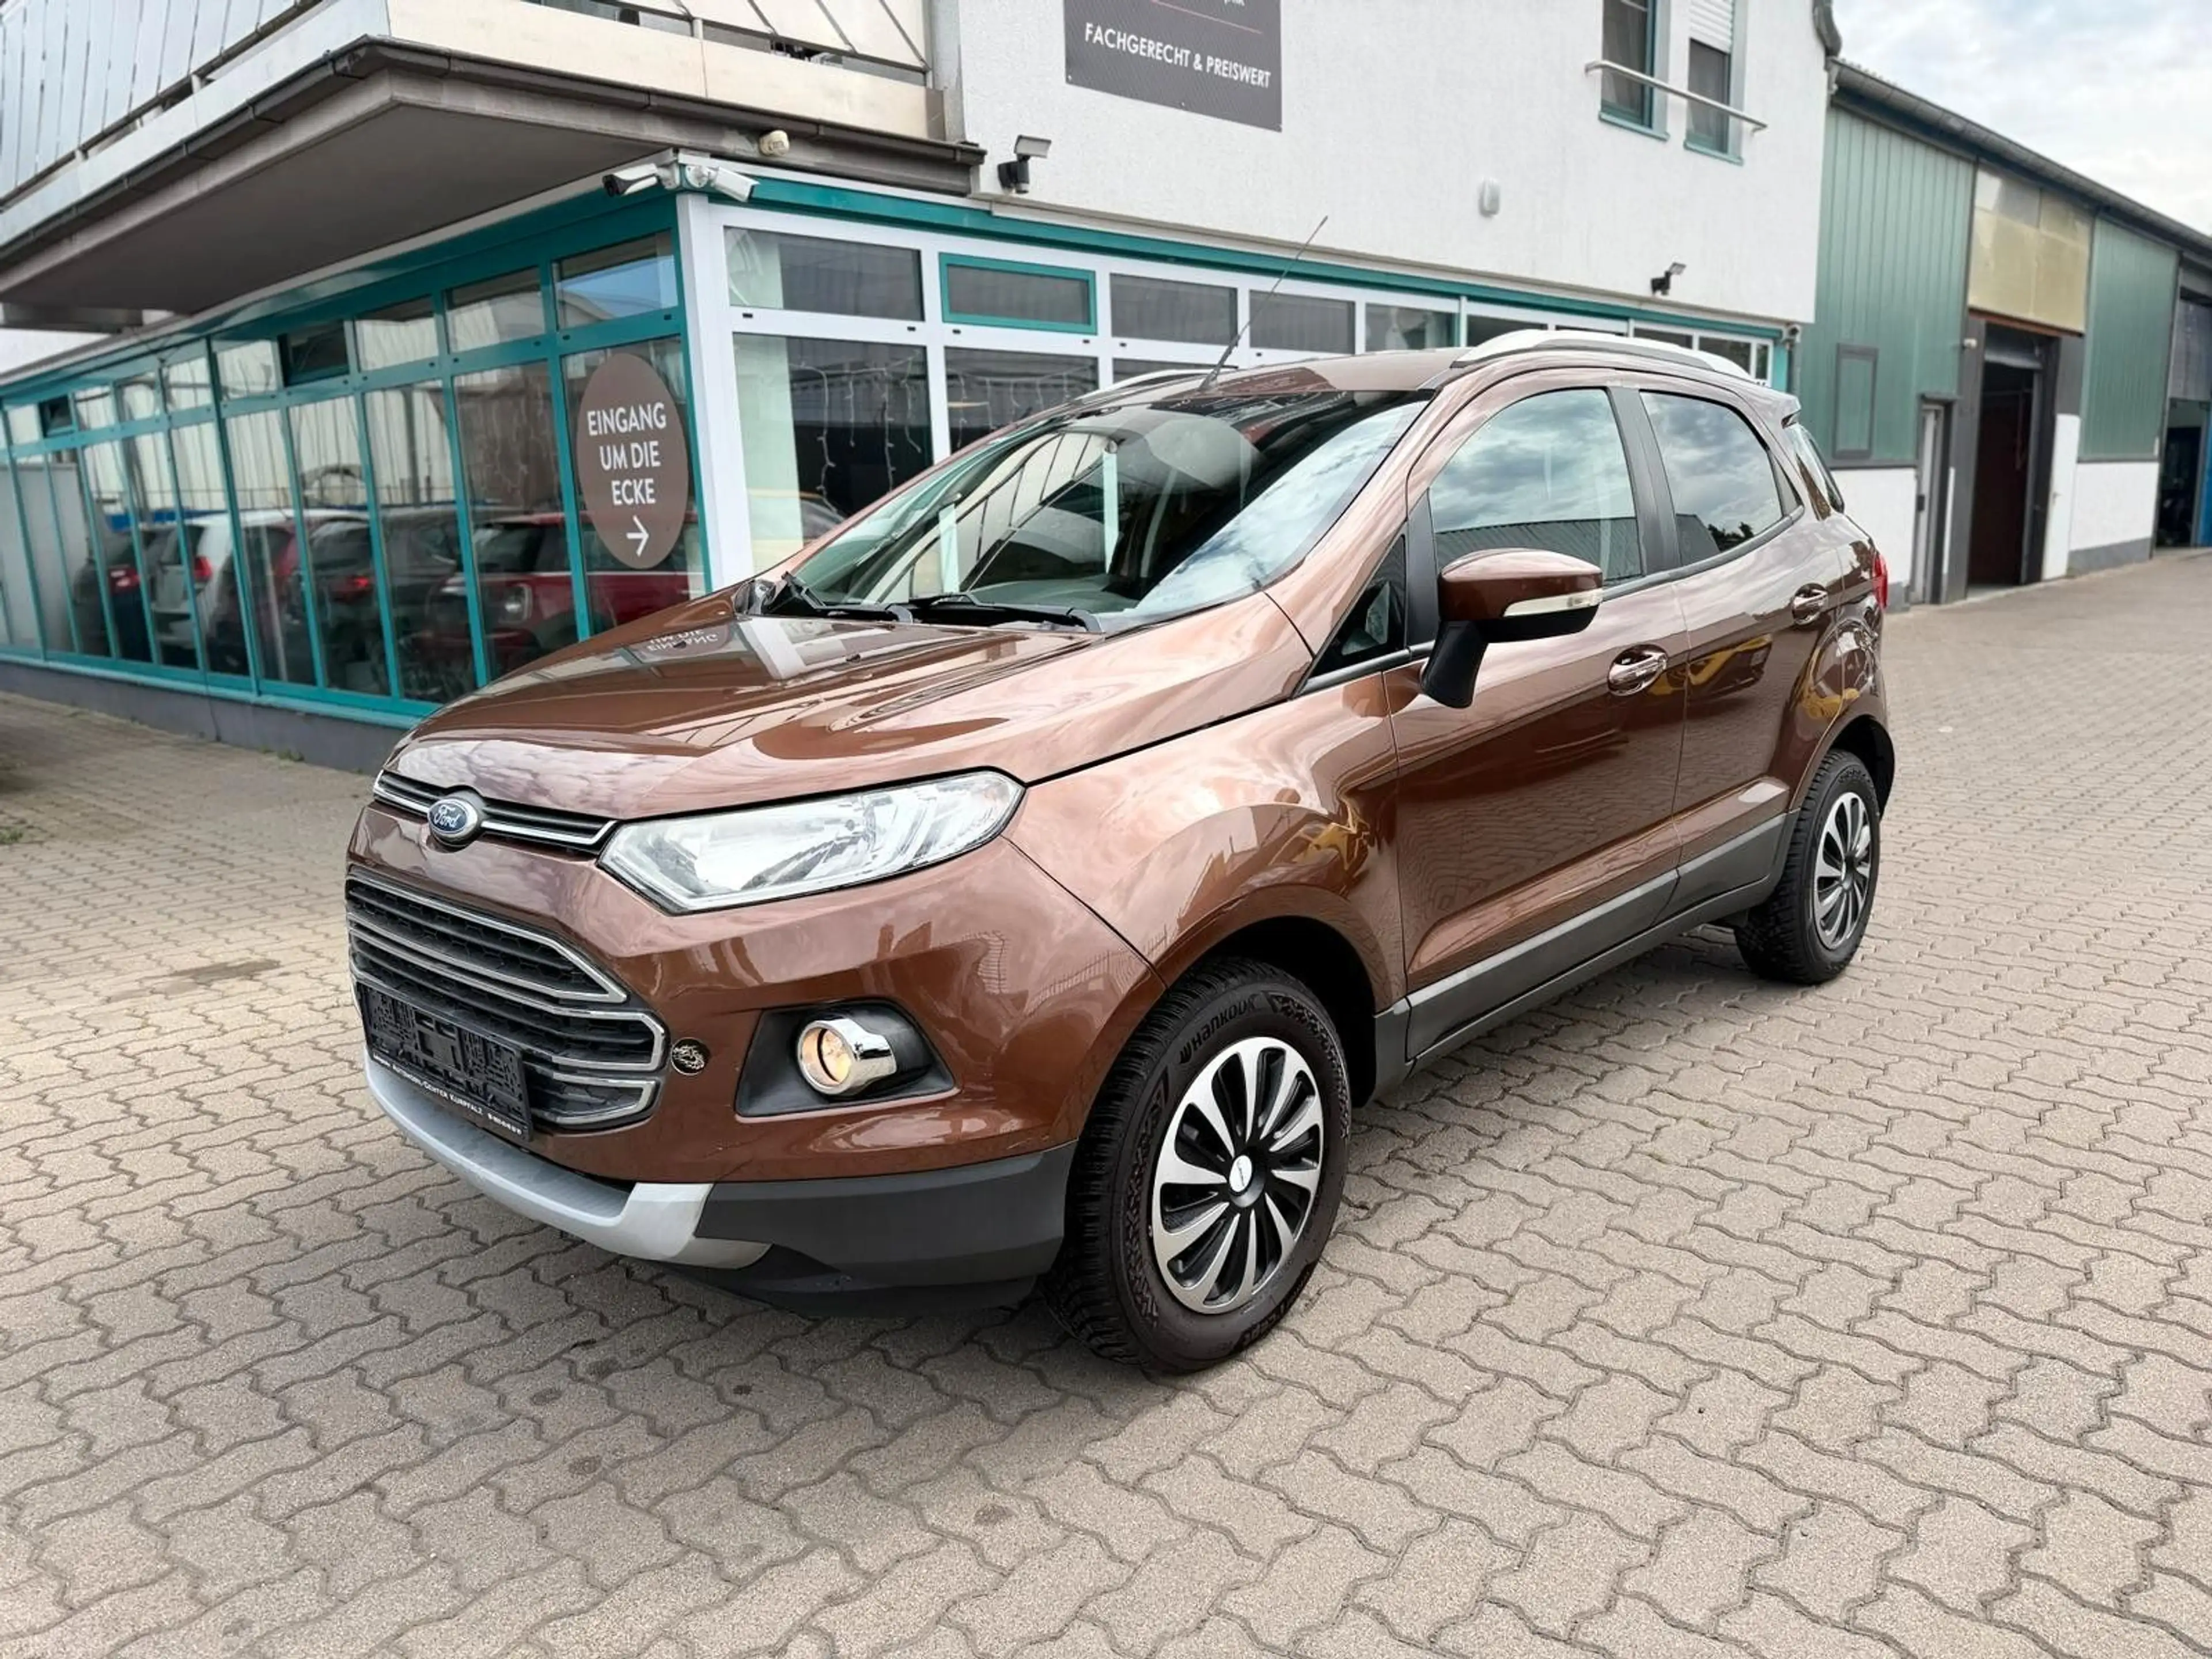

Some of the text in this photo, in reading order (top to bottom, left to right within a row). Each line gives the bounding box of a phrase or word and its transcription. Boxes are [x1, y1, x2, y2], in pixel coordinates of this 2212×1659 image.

[1085, 22, 1271, 88] FACHGERECHT & PREISWERT
[587, 402, 667, 436] EINGANG
[600, 441, 661, 471] UM DIE
[611, 479, 656, 506] ECKE
[433, 804, 461, 828] Ford
